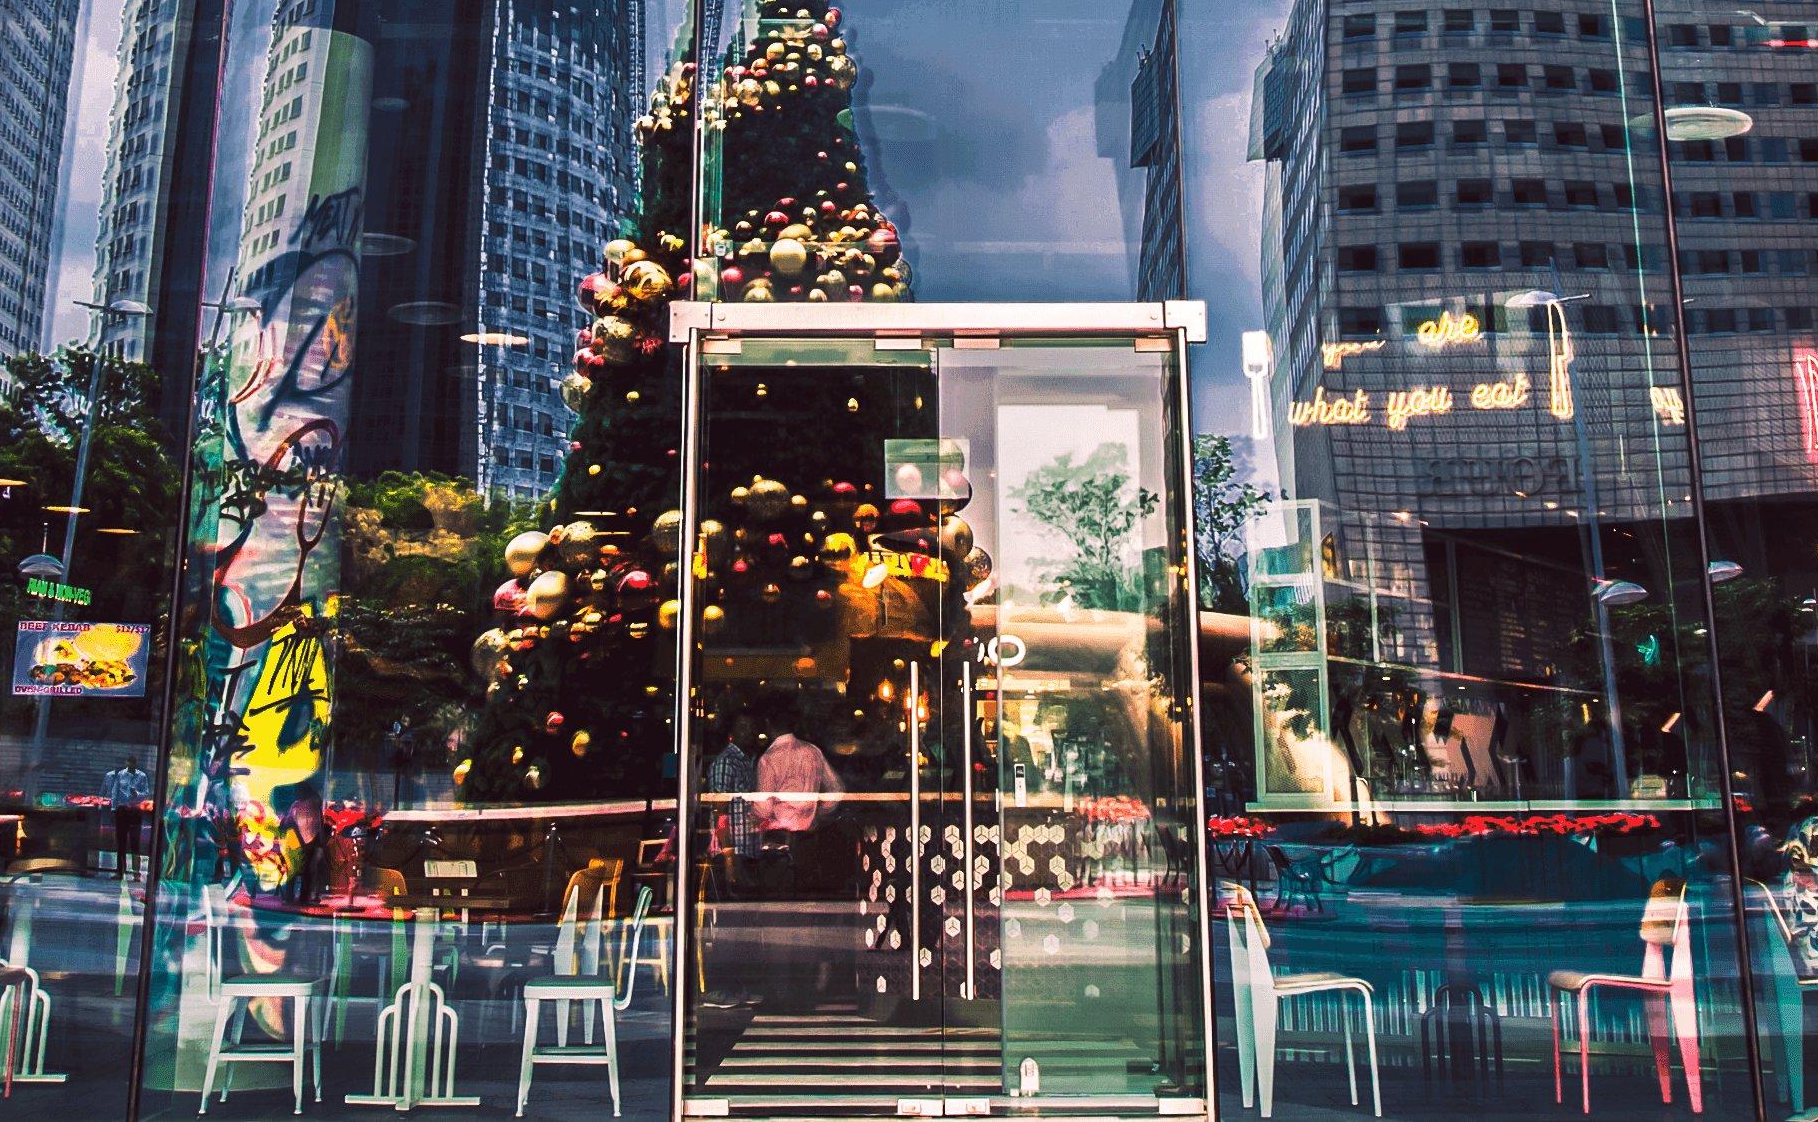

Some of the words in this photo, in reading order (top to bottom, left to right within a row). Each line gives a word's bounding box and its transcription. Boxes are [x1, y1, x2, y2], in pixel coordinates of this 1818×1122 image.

[1417, 310, 1483, 346] are
[1287, 386, 1371, 426] what
[1385, 384, 1453, 431] you
[1471, 373, 1531, 412] eat
[19, 622, 48, 632] BEEF
[52, 622, 91, 632] KEBAB
